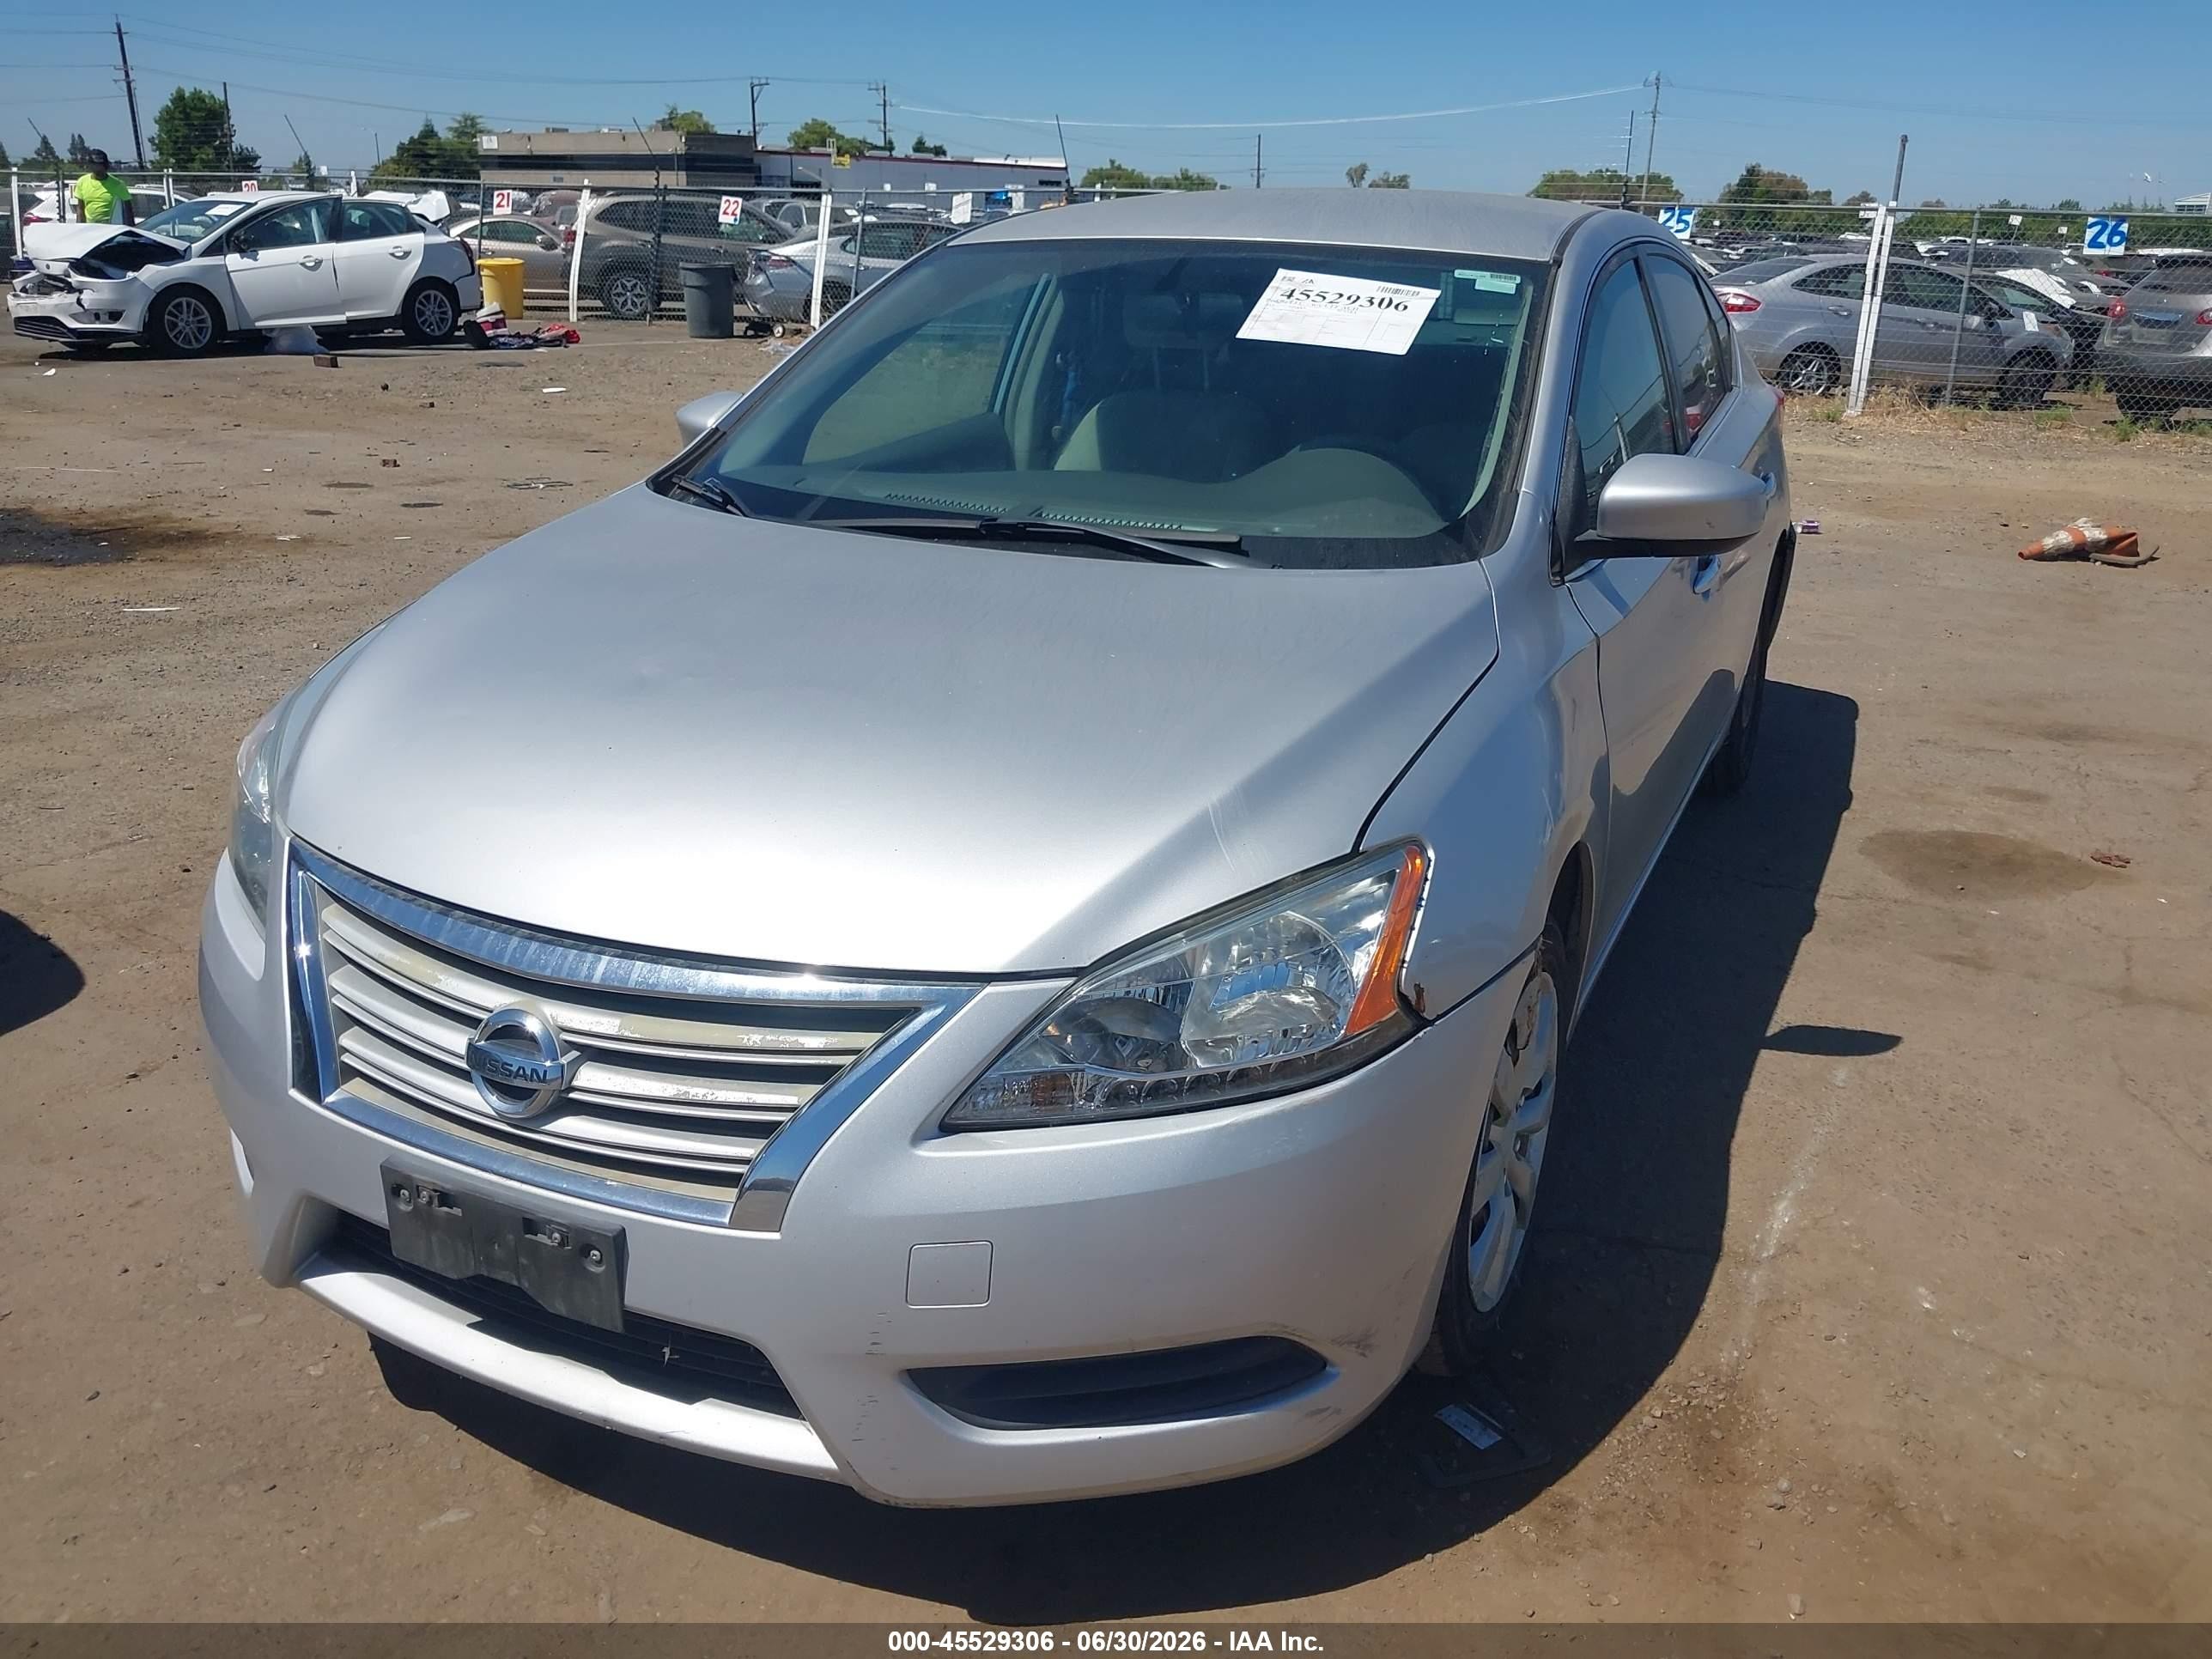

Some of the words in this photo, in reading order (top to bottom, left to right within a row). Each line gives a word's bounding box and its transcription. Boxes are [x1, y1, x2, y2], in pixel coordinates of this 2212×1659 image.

[495, 192, 511, 208] 21
[721, 199, 739, 216] 22
[1662, 206, 1692, 234] 25
[2087, 217, 2126, 248] 26
[1280, 288, 1413, 312] 45529306
[470, 1050, 548, 1084] NISSAN
